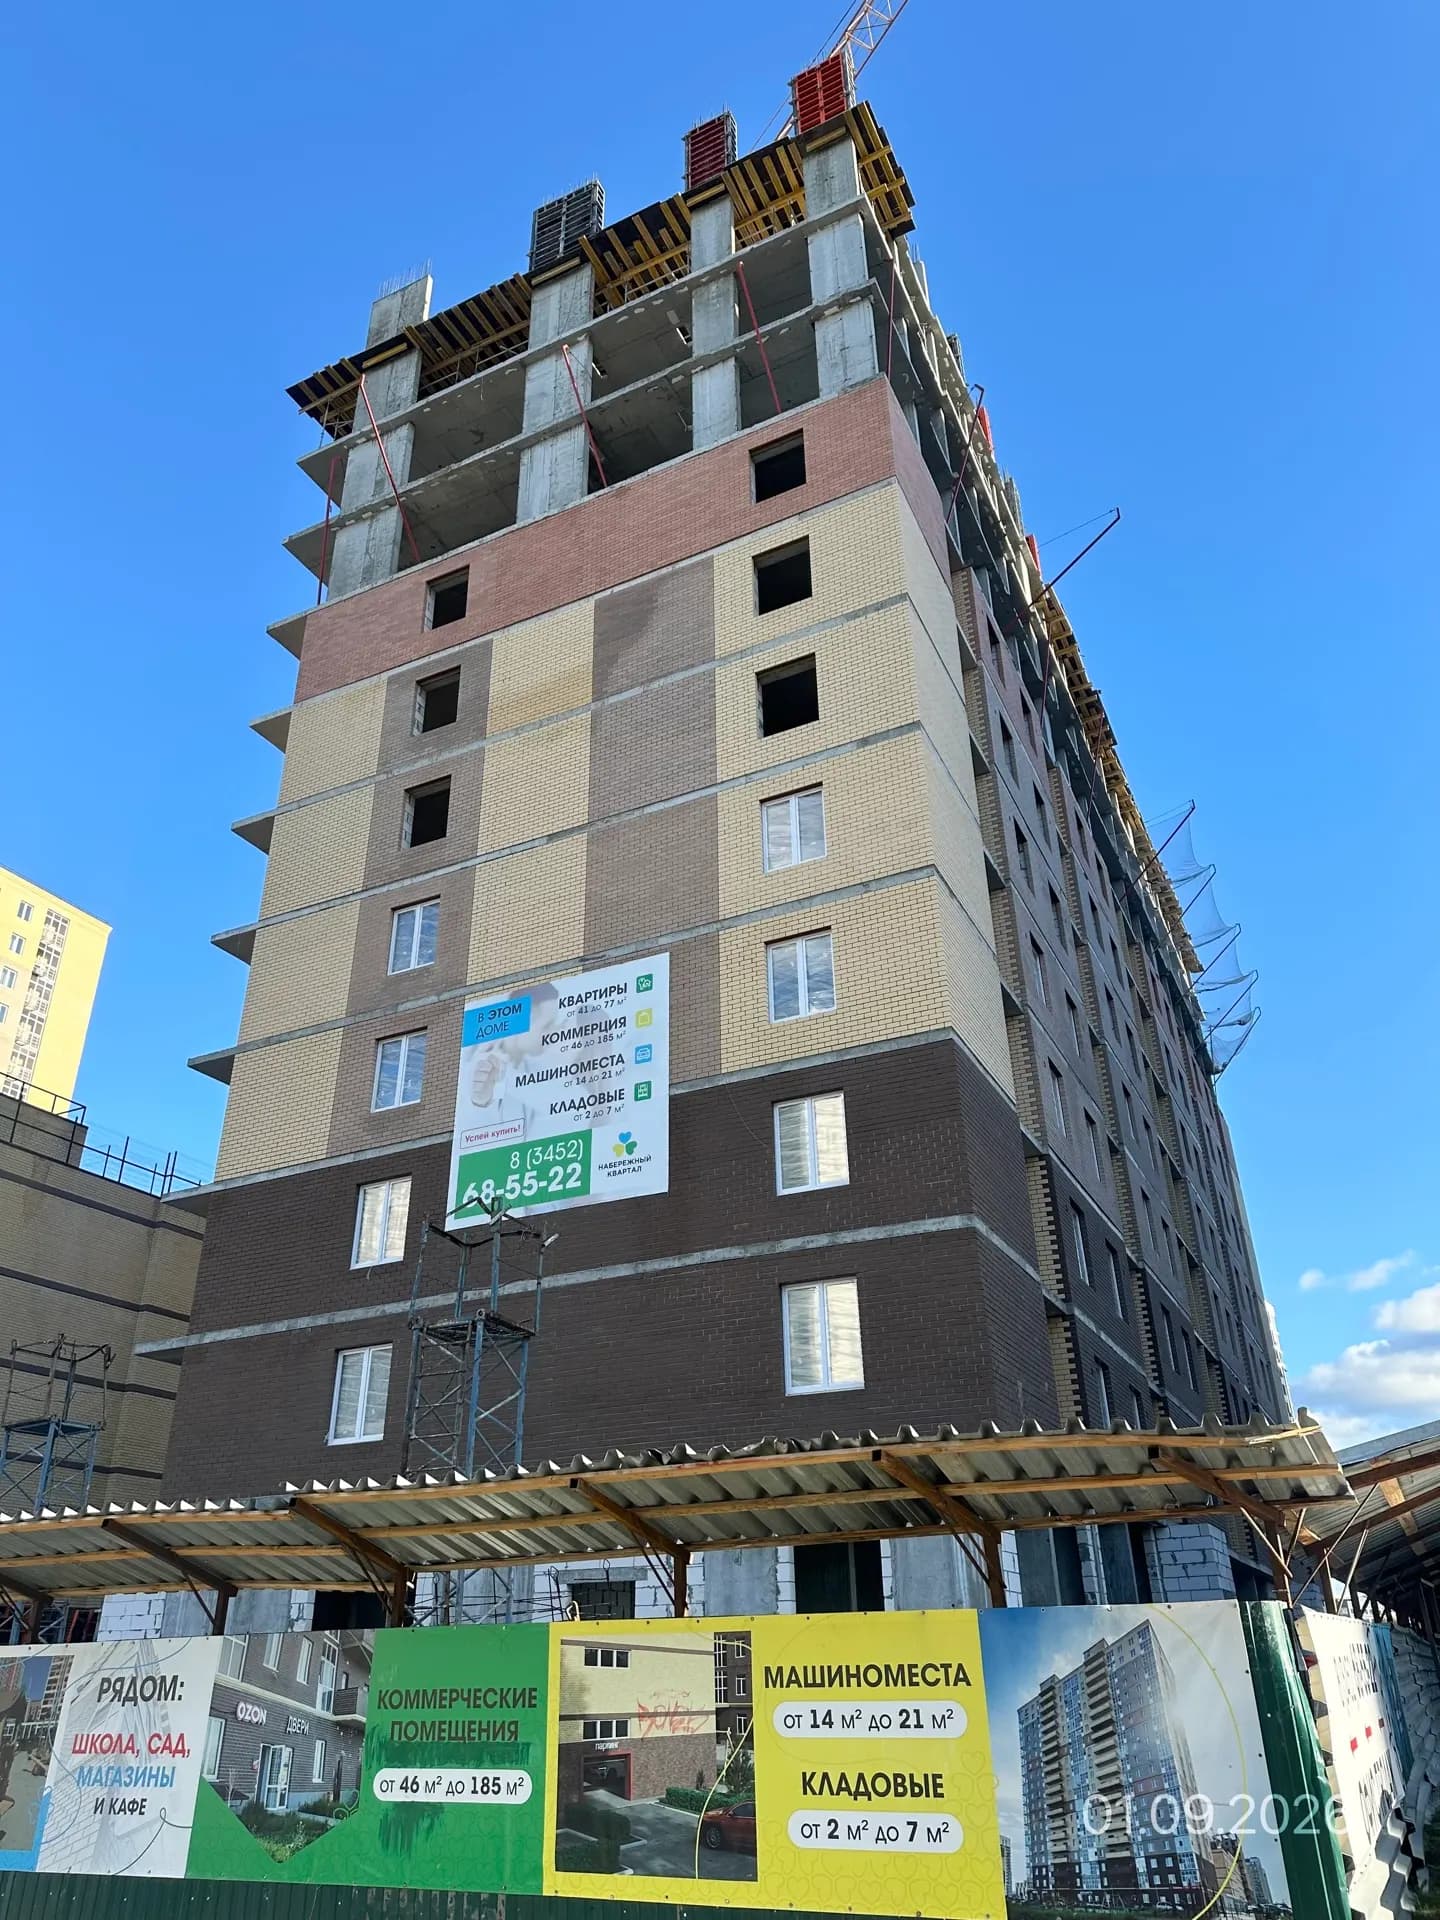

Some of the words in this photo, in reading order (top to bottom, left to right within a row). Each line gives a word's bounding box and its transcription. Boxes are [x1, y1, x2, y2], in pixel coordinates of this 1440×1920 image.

[558, 982, 628, 1009] КВАРТИРЫ
[604, 999, 615, 1008] 77
[477, 1012, 485, 1022] В
[487, 1003, 522, 1021] ЭТОМ
[476, 1020, 510, 1040] ДОМЕ
[541, 1016, 627, 1046] КОММЕРЦИЯ
[571, 1041, 582, 1049] 46
[597, 1033, 614, 1044] 185
[515, 1053, 625, 1088] МАШИНОМЕСТА
[575, 1076, 586, 1085] 14
[601, 1070, 612, 1080] 21
[549, 1088, 625, 1115] КЛАДОВЫЕ
[585, 1110, 591, 1119] 2
[606, 1106, 612, 1115] 7
[465, 1131, 490, 1143] Успей
[491, 1124, 521, 1139] купить!
[510, 1151, 520, 1169] 8
[526, 1139, 584, 1170] (3452)
[598, 1155, 652, 1171] НАБЕРЕЖНЫЙ
[607, 1165, 643, 1178] КВАРТАЛ
[463, 1162, 582, 1208] 68-55-22
[763, 1663, 972, 1689] МАШИНОМЕСТА
[97, 1674, 185, 1707] РЯДОМ:
[377, 1687, 538, 1710] КОММЕРЧЕСКИЕ
[236, 1701, 268, 1726] OZON
[783, 1714, 802, 1729] от
[809, 1709, 834, 1729] 14
[868, 1714, 892, 1732] до
[898, 1709, 924, 1729] 21
[286, 1715, 310, 1736] ДВЕРИ
[390, 1720, 519, 1743] ПОМЕЩЕНИЯ
[71, 1733, 140, 1758] ШКОЛА,
[147, 1732, 191, 1758] САД,
[76, 1765, 176, 1788] МАГАЗИНЫ
[379, 1779, 395, 1793] от
[399, 1775, 420, 1794] 46
[445, 1780, 465, 1796] до
[471, 1776, 501, 1795] 185
[801, 1771, 945, 1801] КЛАДОВЫЕ
[93, 1798, 105, 1815] И
[107, 1797, 148, 1816] КАФЕ
[800, 1823, 821, 1839] от
[827, 1819, 840, 1839] 2
[875, 1826, 899, 1844] до
[906, 1821, 918, 1842] 7
